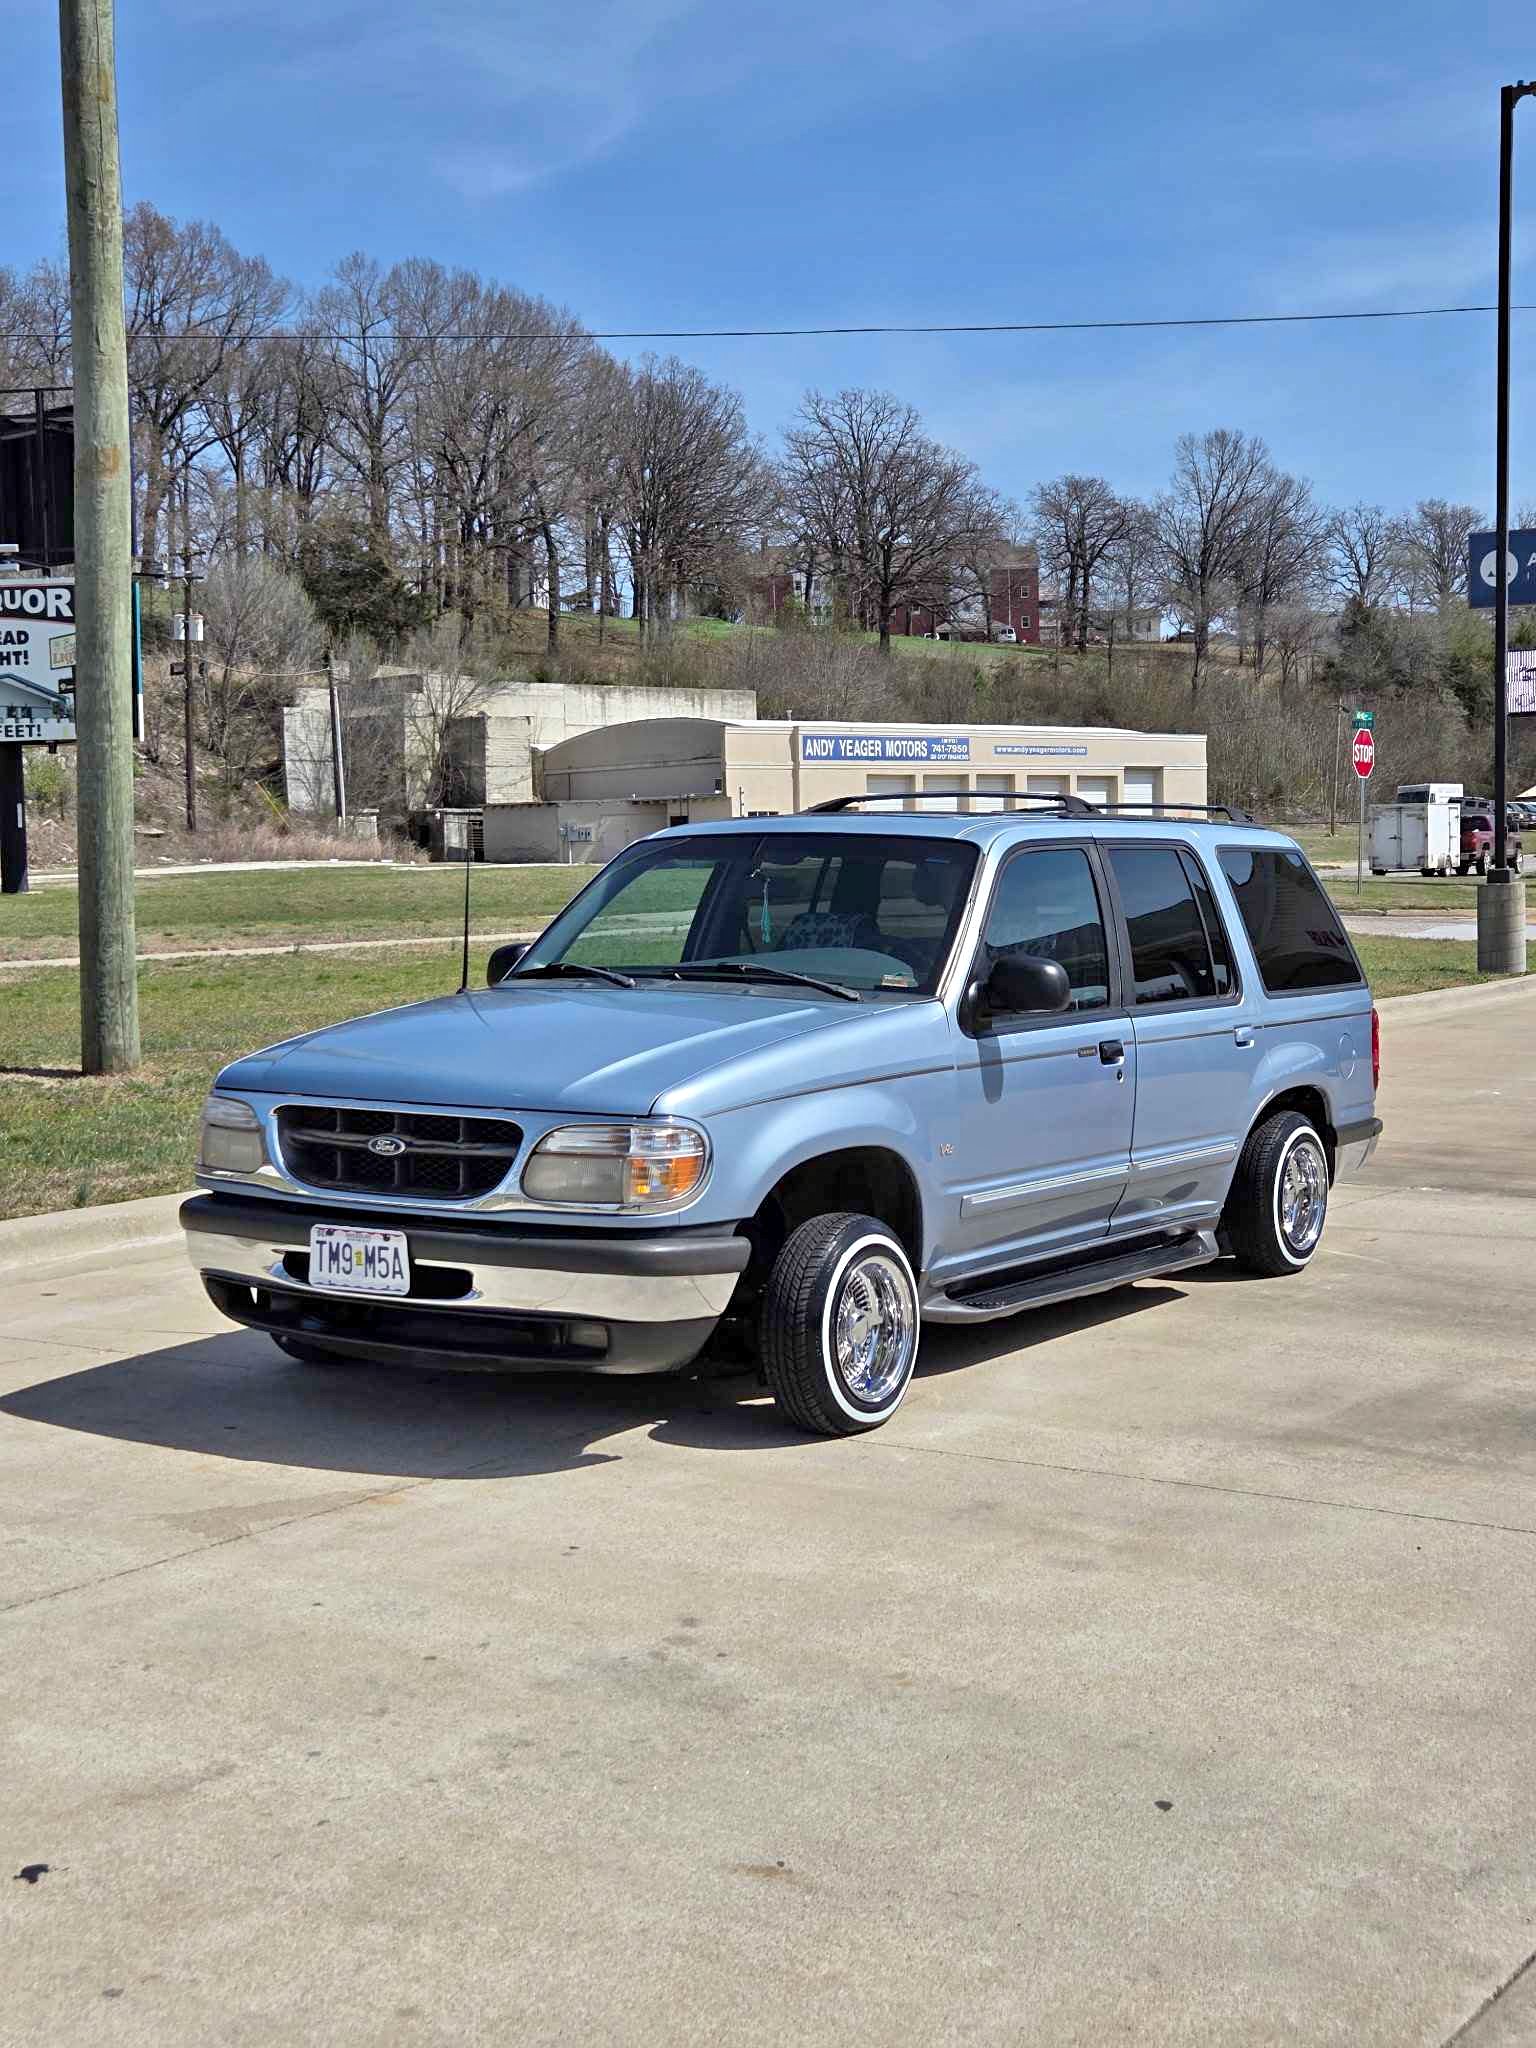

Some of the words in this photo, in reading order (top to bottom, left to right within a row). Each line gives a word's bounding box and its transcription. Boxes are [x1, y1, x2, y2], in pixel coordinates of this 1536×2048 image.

[0, 588, 73, 617] UOR
[0, 630, 29, 645] AD
[805, 739, 835, 757] ANDY
[839, 739, 882, 757] YEAGER
[886, 740, 928, 758] MOTORS
[931, 744, 968, 753] 741-7950
[1354, 743, 1373, 763] STOP
